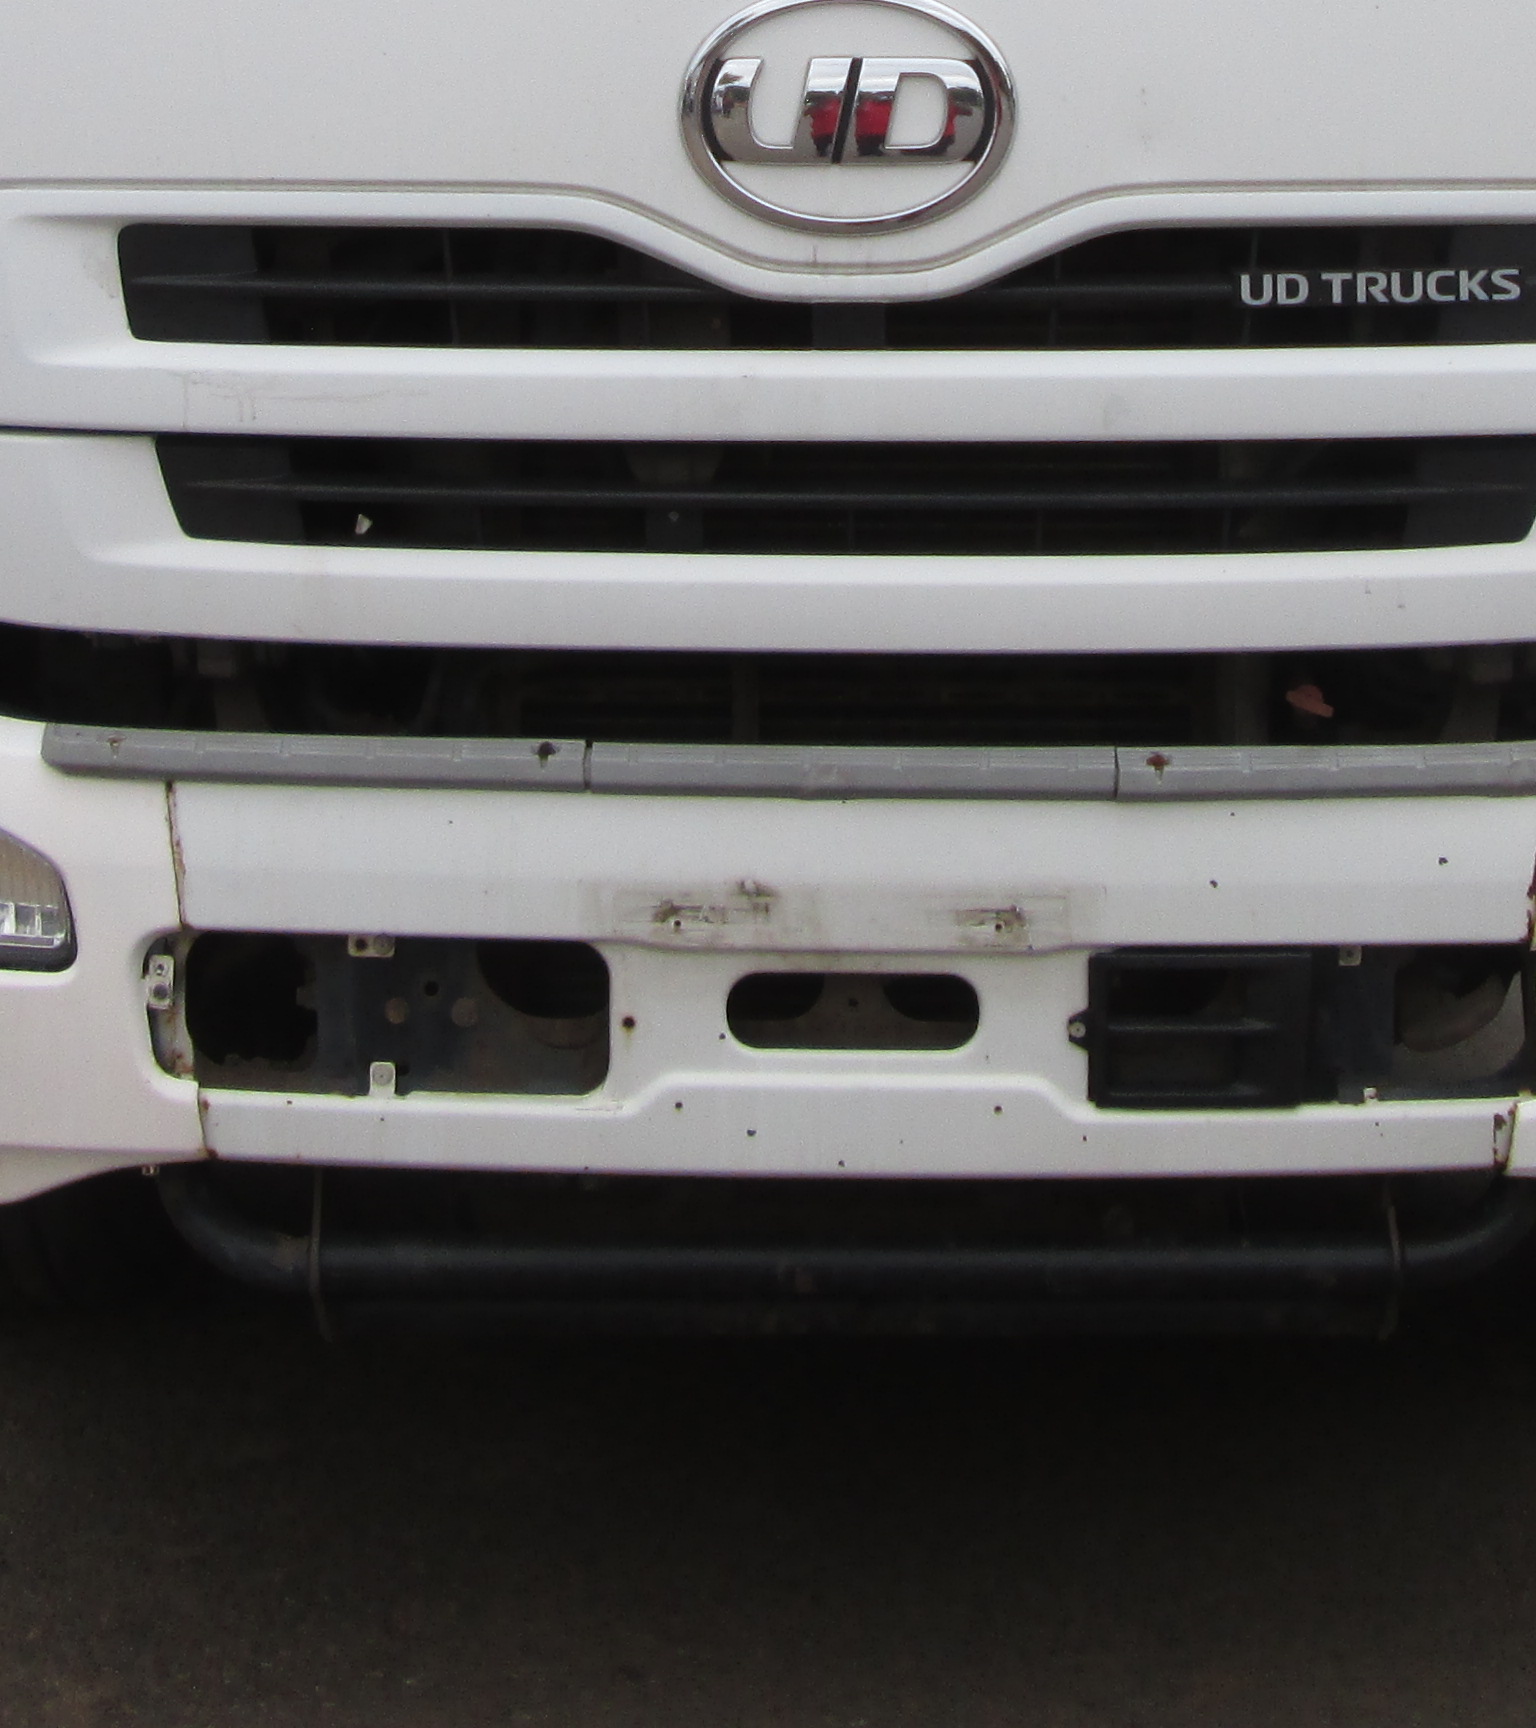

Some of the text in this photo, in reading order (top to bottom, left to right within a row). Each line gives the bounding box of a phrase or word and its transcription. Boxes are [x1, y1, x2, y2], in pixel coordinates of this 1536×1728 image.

[713, 56, 985, 165] UD
[1240, 269, 1522, 306] UD TRUCKS
